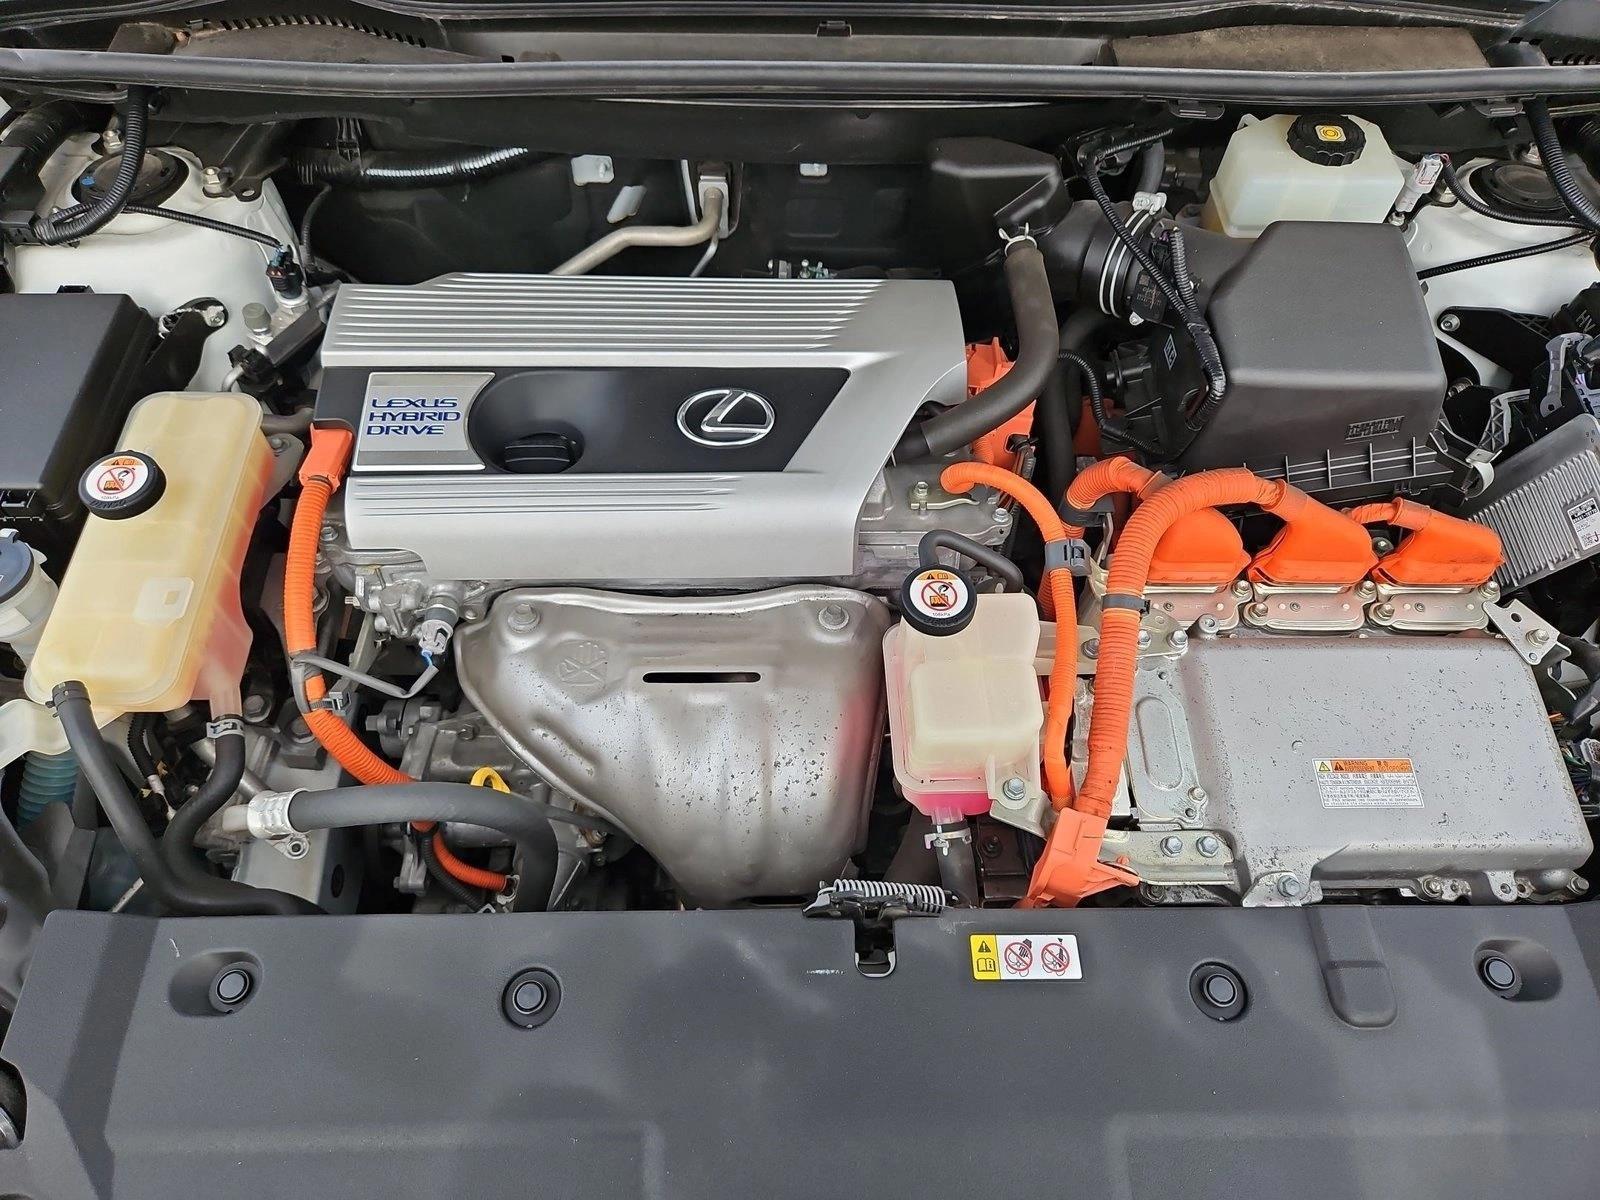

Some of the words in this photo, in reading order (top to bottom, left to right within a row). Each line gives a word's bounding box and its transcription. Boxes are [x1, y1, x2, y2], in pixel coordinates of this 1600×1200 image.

[371, 398, 458, 408] LEXUS
[369, 411, 461, 421] HYBRID
[366, 425, 445, 435] DRIVE
